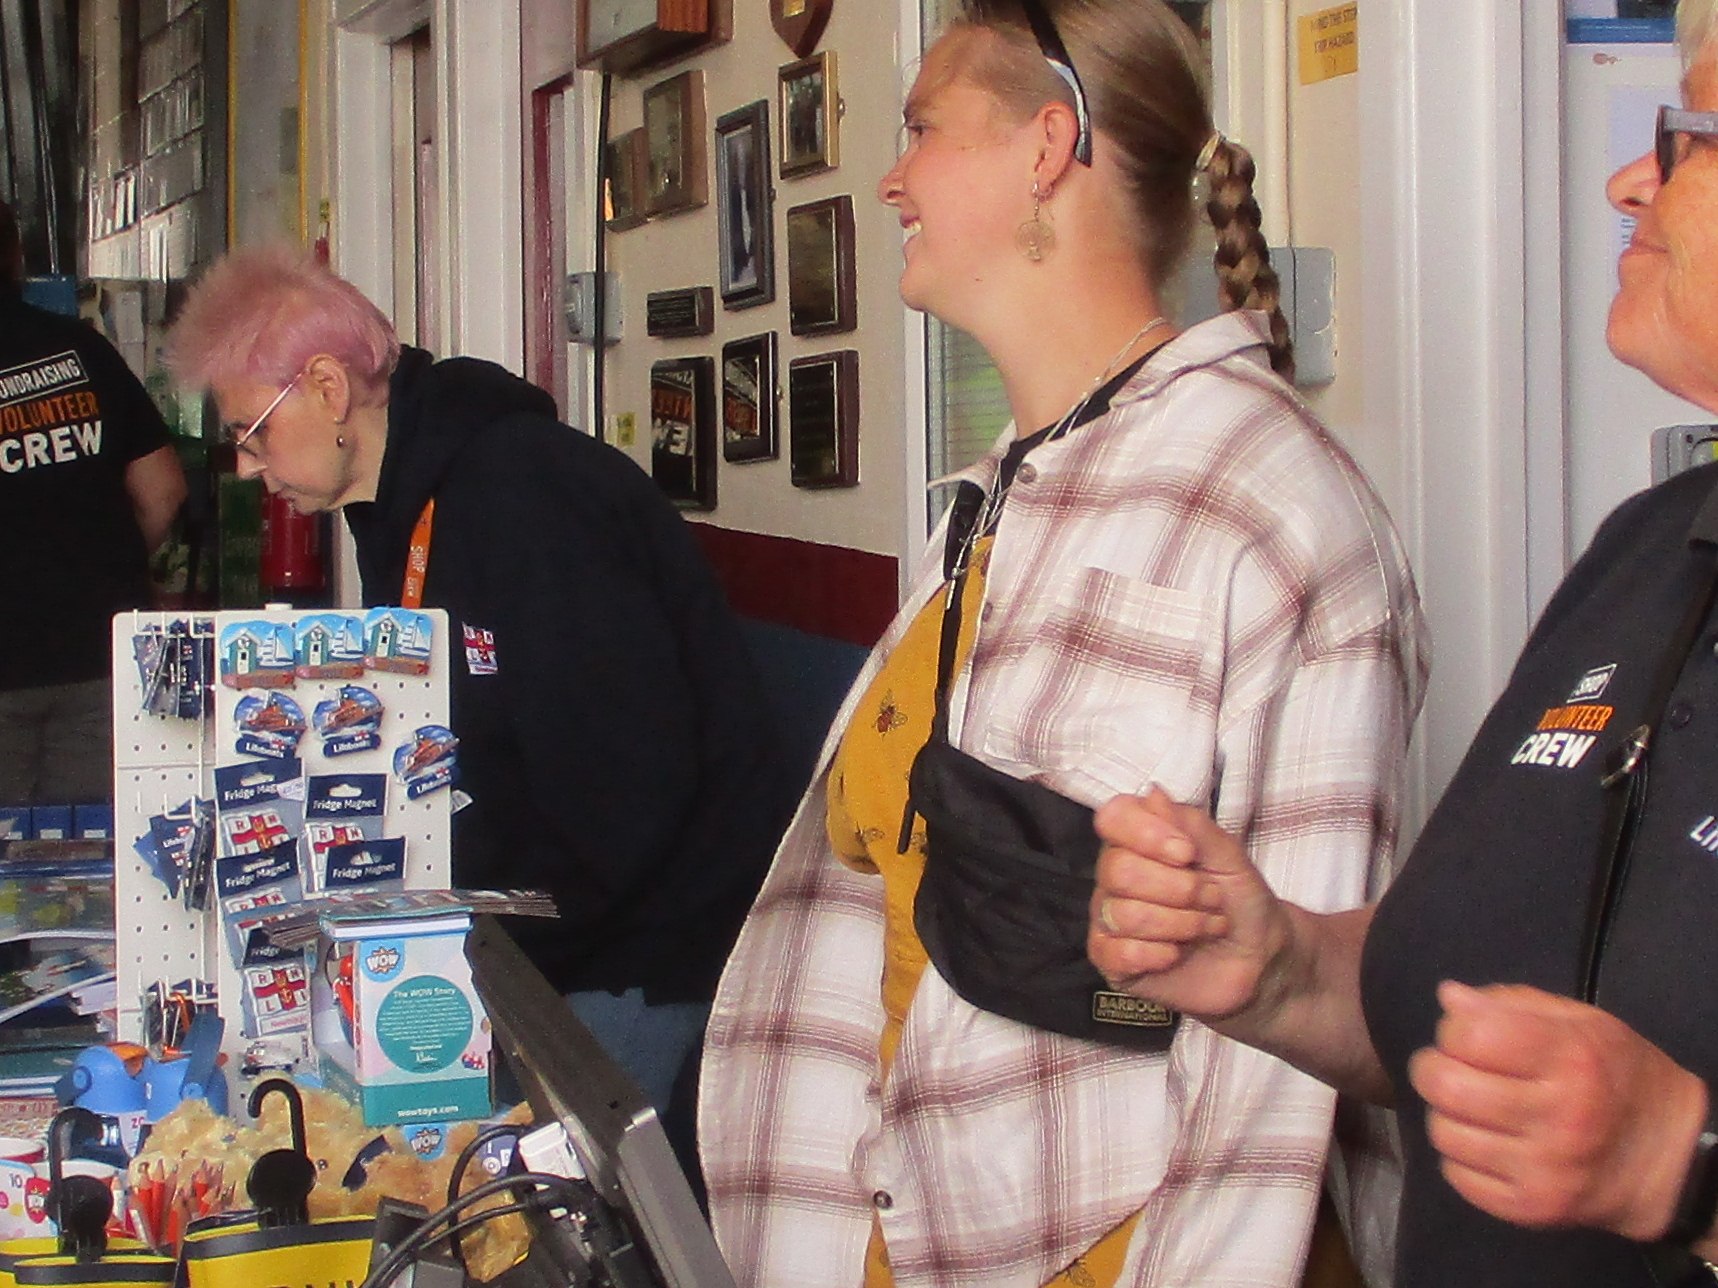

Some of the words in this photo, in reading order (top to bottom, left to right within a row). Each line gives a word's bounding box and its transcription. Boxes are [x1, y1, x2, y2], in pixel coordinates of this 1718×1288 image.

[1536, 705, 1614, 732] VOLUNTEER
[1511, 732, 1597, 769] CREW
[224, 786, 255, 801] Fridge
[257, 782, 279, 797] Mag
[313, 799, 342, 812] Fridge
[344, 798, 378, 811] Magnet
[225, 871, 255, 888] Fridge
[332, 866, 363, 880] Fridge
[366, 954, 400, 971] WOW
[1099, 996, 1166, 1013] BARBOU
[397, 1104, 459, 1118] wowtoys.com
